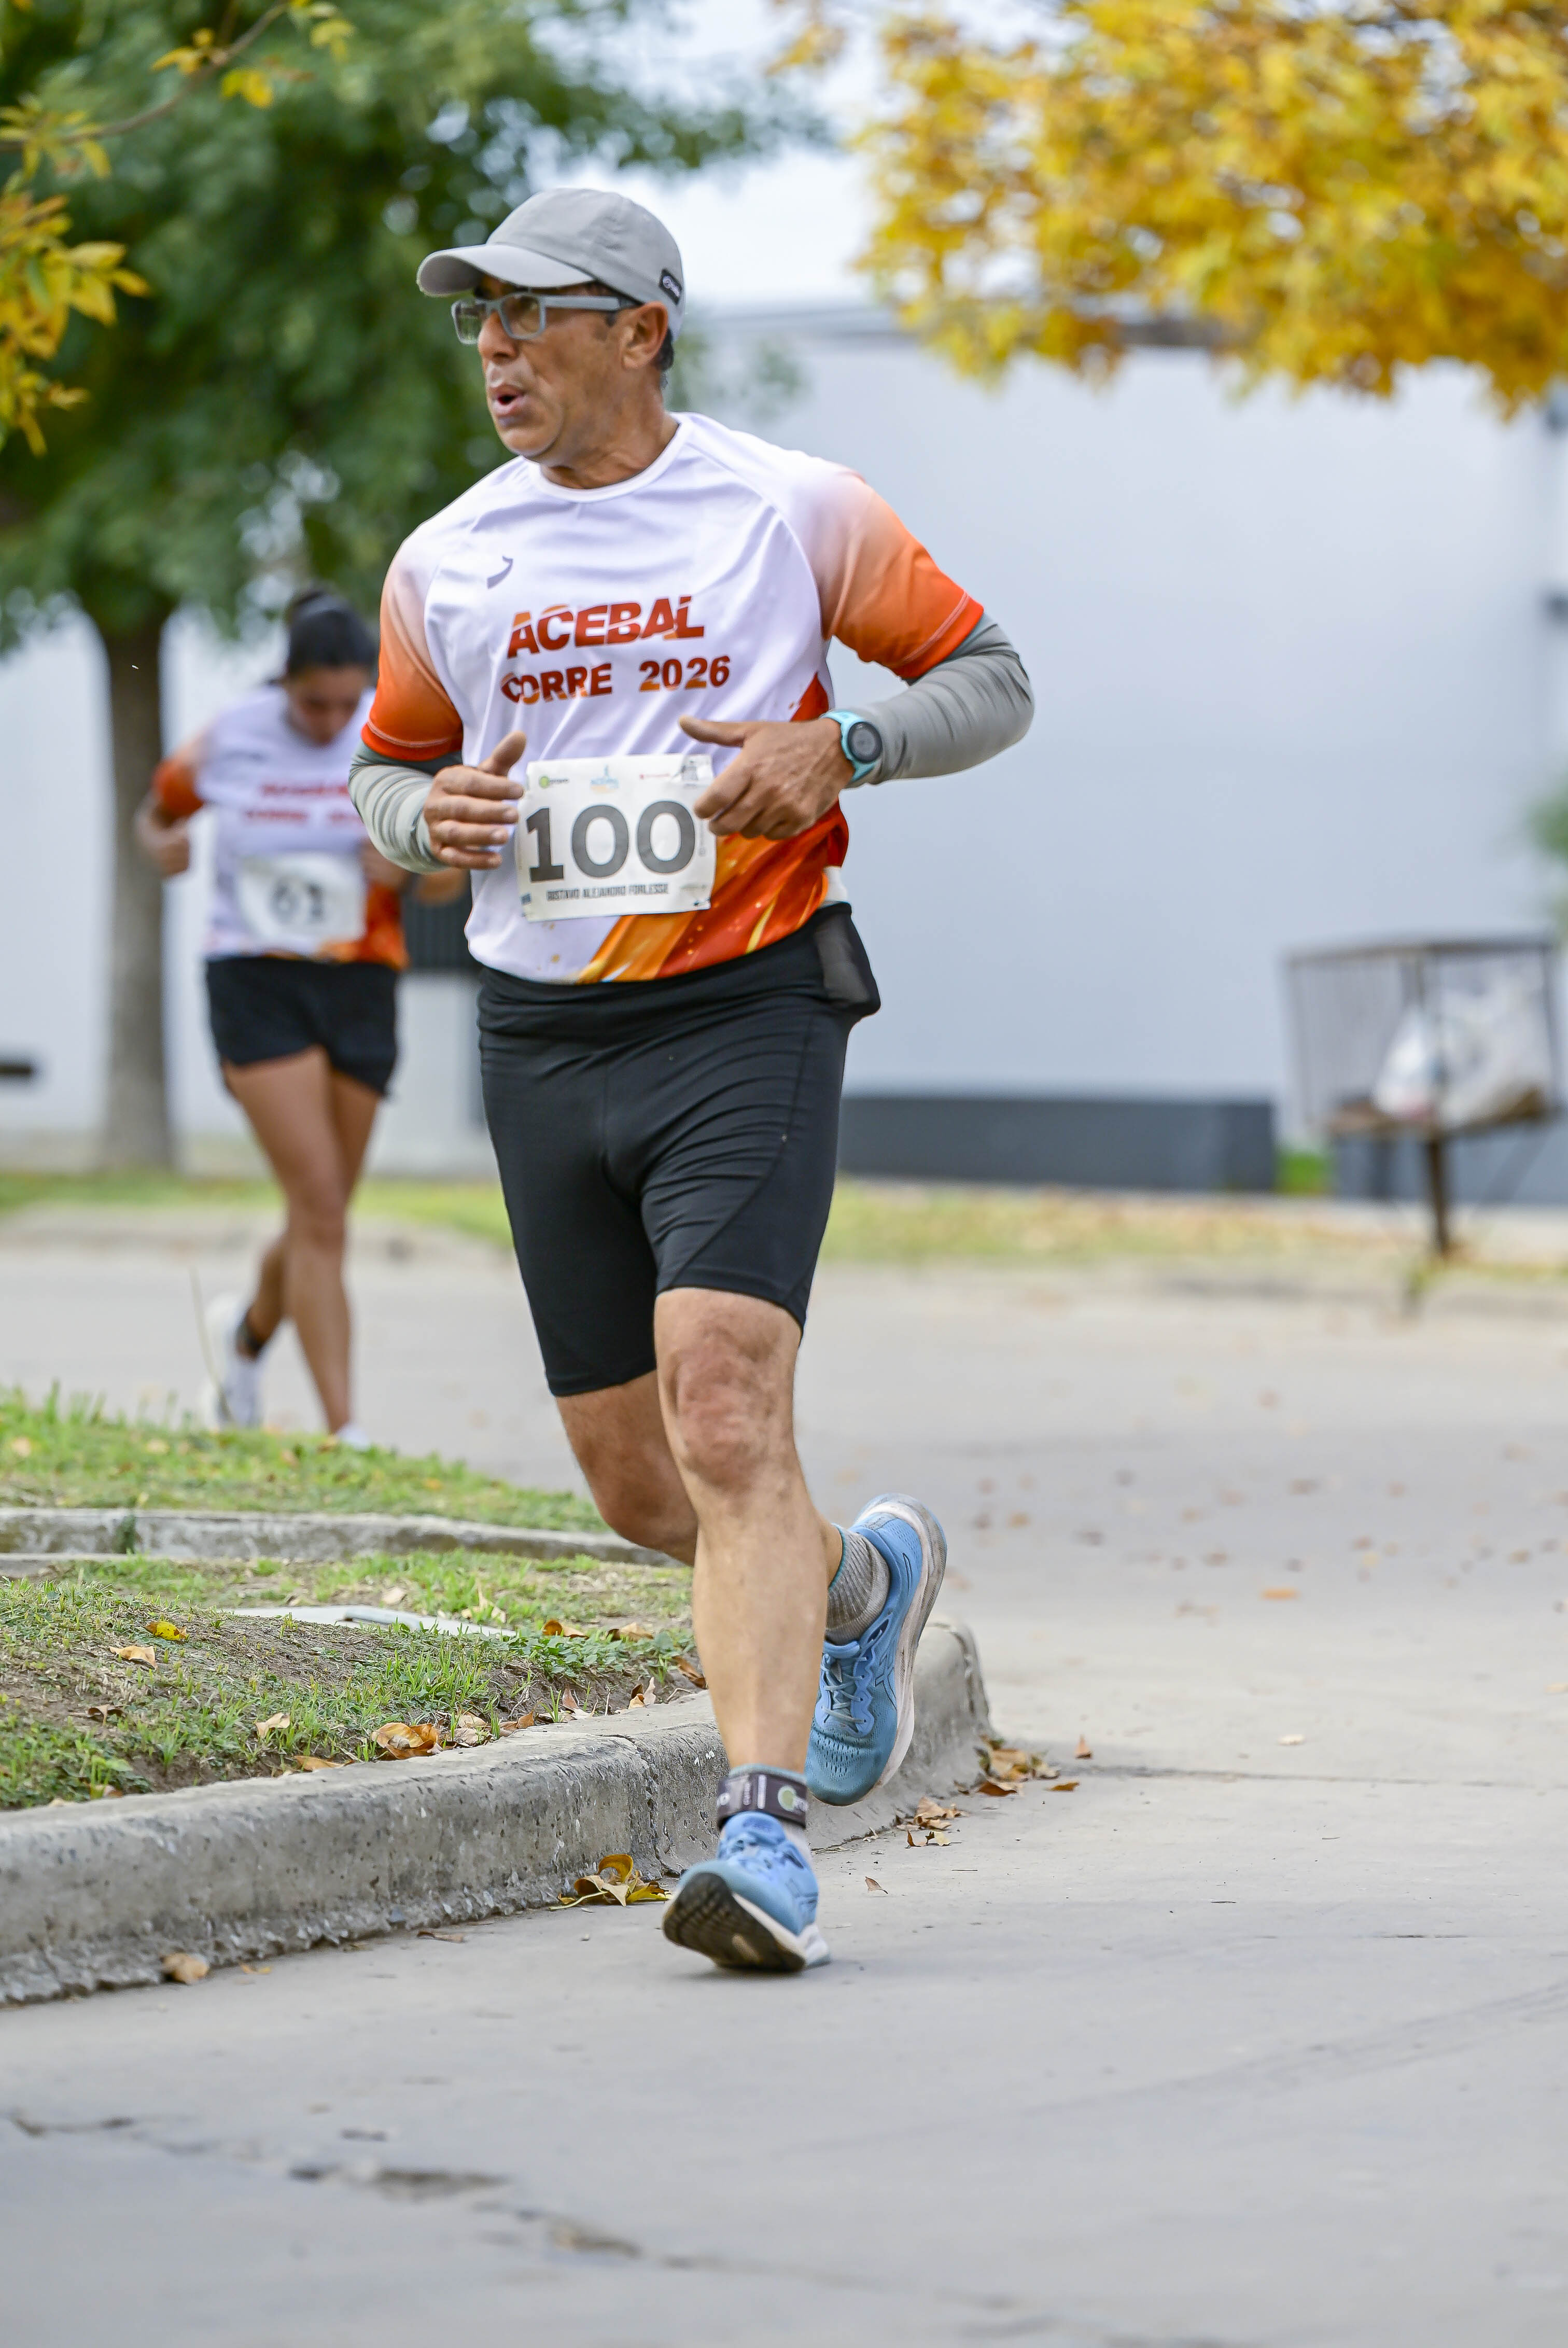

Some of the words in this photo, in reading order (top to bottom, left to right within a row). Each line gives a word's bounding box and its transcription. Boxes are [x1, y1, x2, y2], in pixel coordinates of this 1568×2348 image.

[507, 596, 704, 659] ACEBAL
[501, 663, 612, 704] CORRE
[639, 655, 730, 692] 2026
[526, 801, 695, 882] 100
[583, 886, 625, 898] ALEJANDRO
